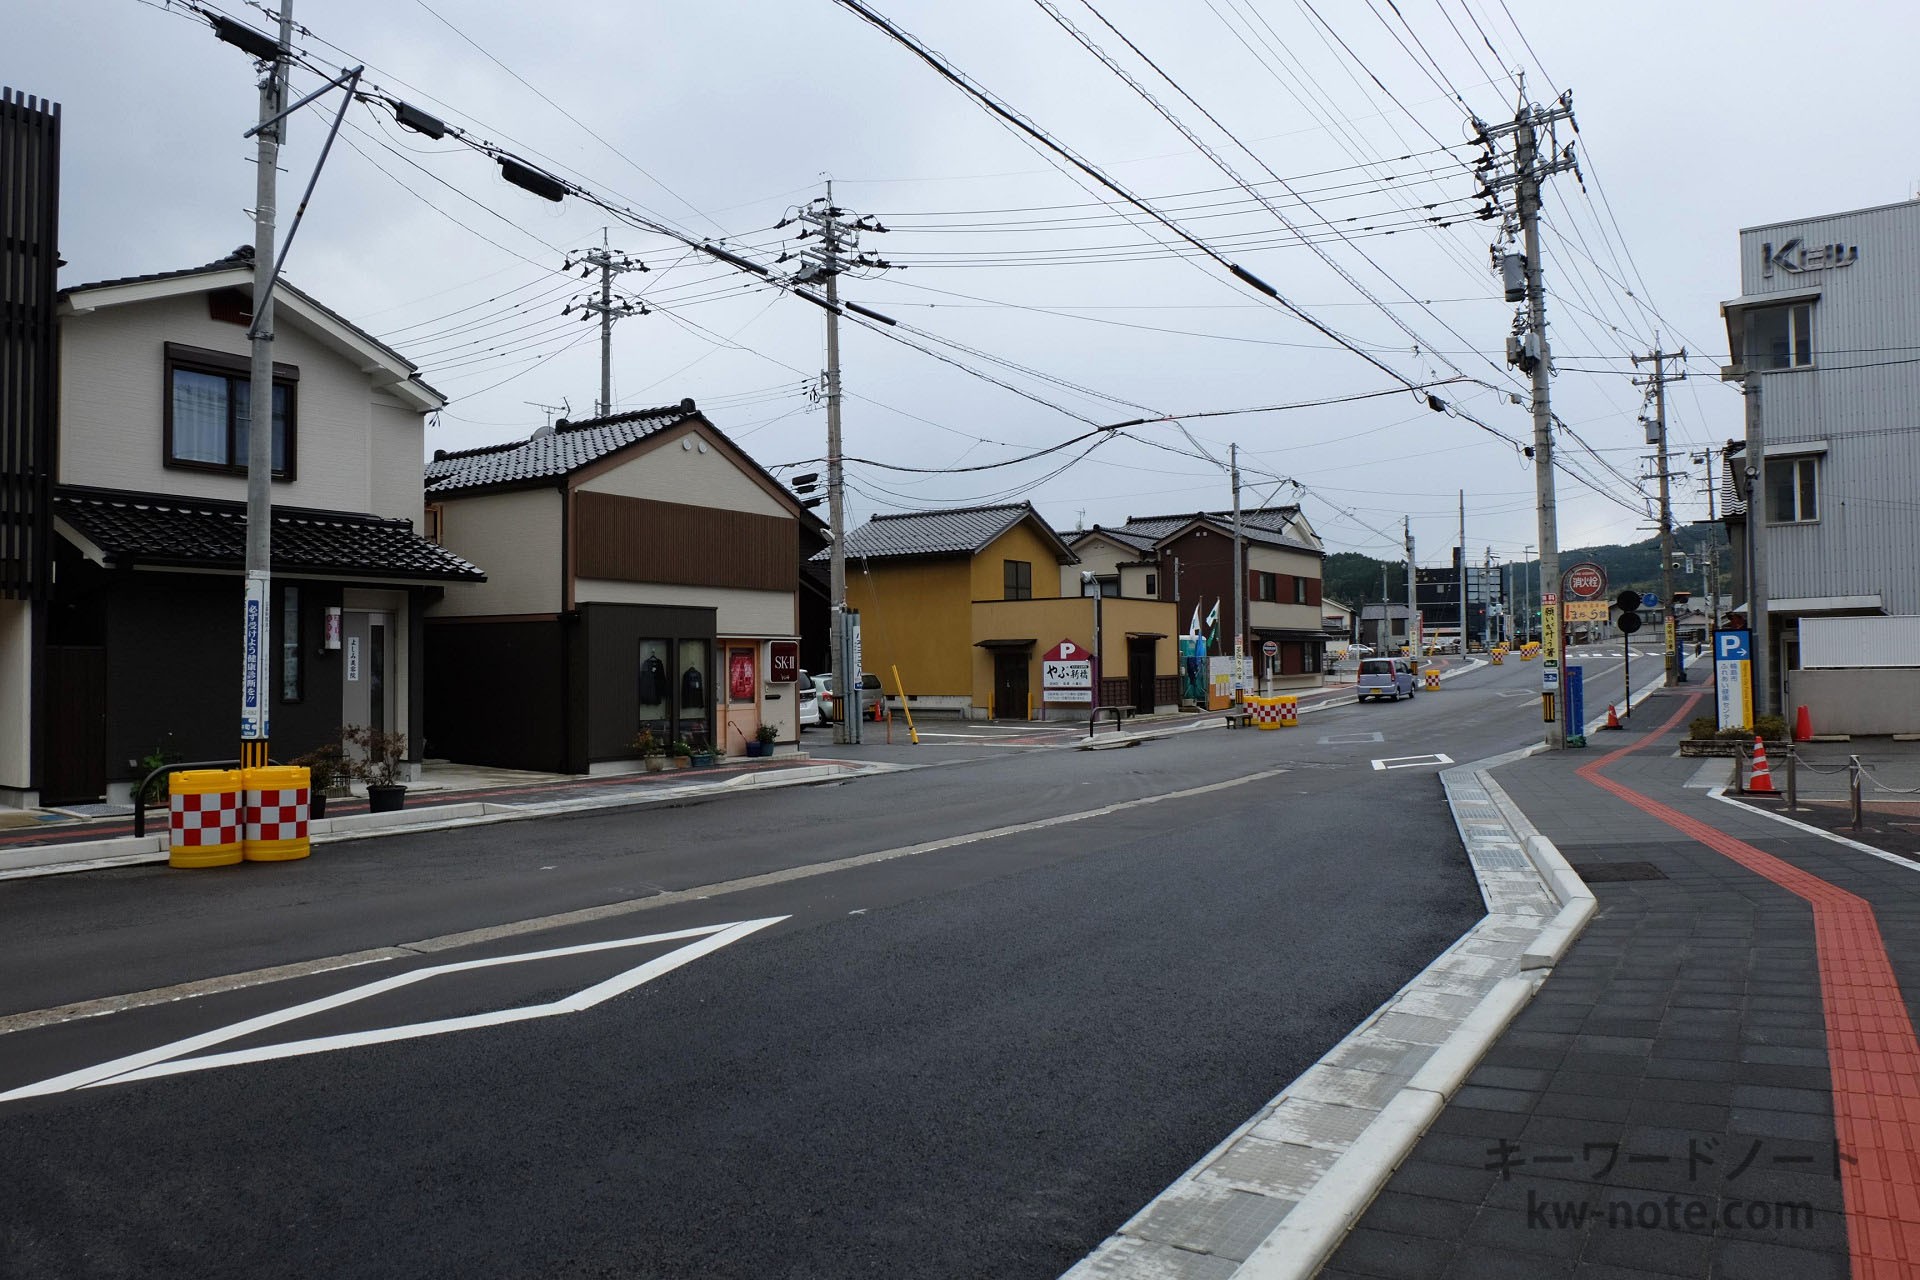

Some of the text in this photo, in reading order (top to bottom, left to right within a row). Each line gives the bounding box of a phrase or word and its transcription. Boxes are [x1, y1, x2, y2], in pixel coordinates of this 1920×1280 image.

[1573, 577, 1599, 588] 消火栓
[1061, 643, 1076, 659] P
[1721, 635, 1740, 657] P
